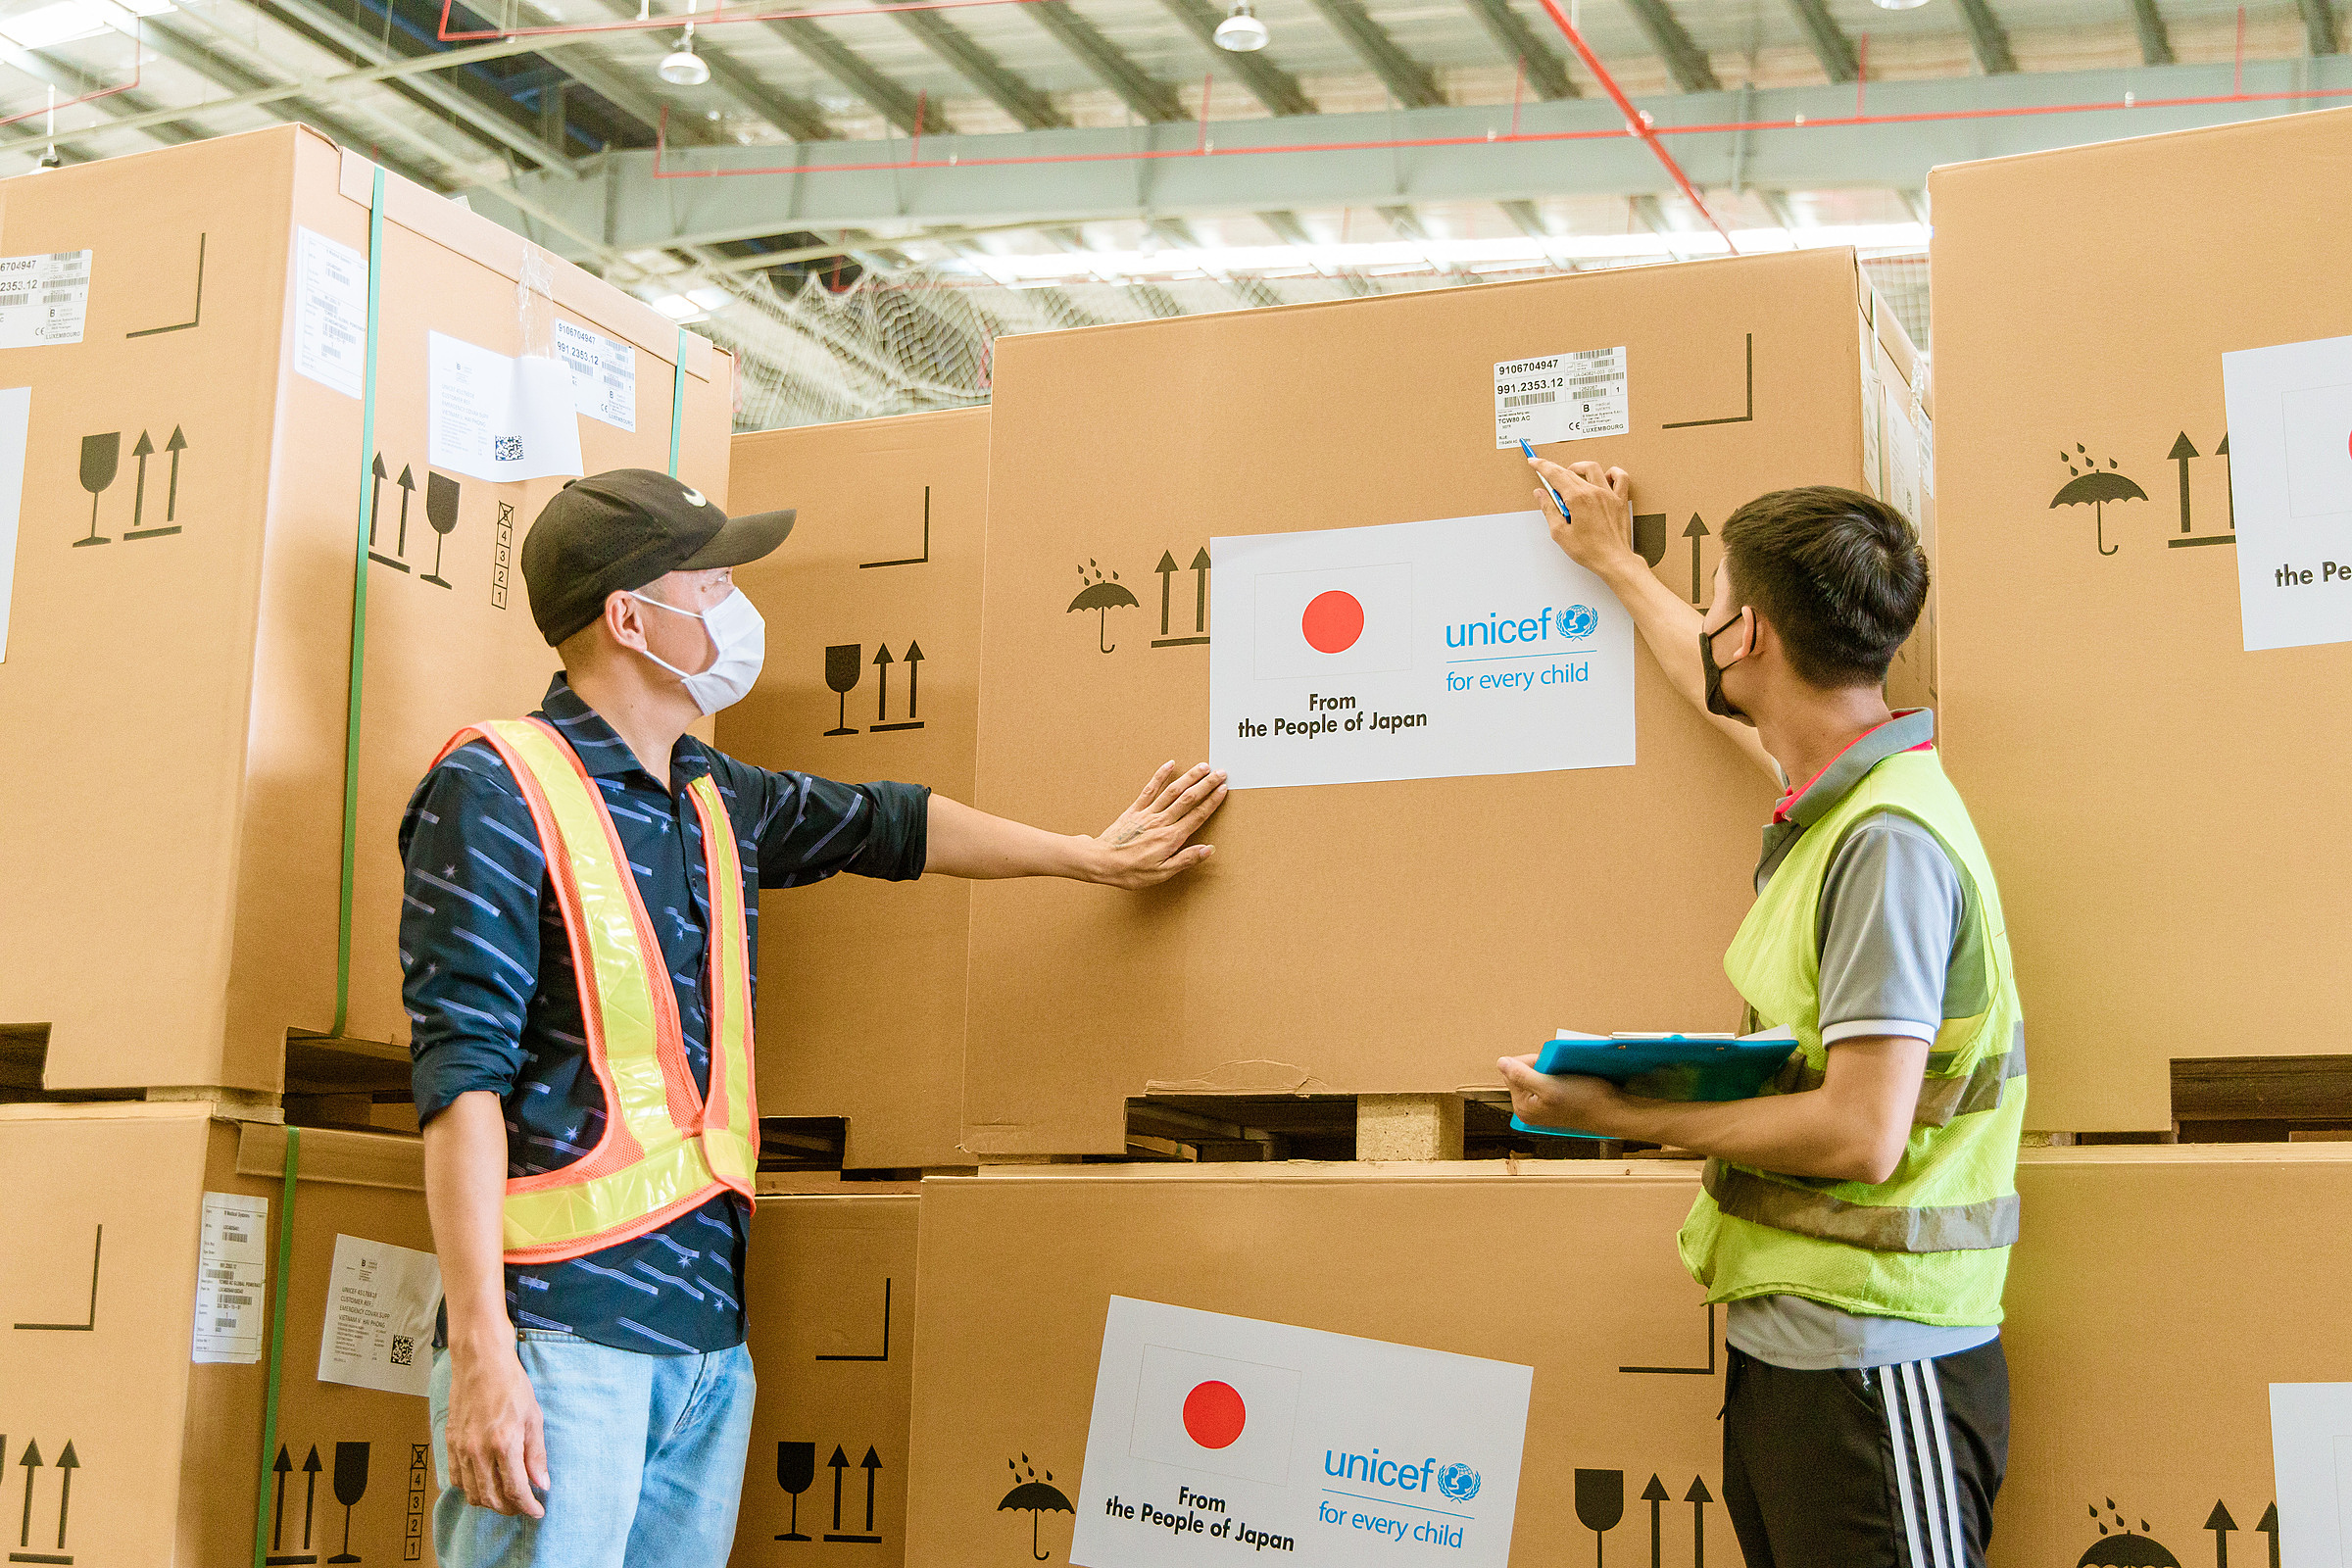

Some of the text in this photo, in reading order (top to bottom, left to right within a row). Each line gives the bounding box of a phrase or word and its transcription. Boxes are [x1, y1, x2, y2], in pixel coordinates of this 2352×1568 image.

[50, 309, 55, 318] B
[559, 323, 596, 345] 9106704947
[1498, 359, 1558, 375] 9106704947
[1497, 378, 1564, 395] 991.2353.12
[1583, 404, 1590, 413] B
[1582, 423, 1624, 433] LUXEMBOURG
[502, 530, 507, 541] 4
[500, 550, 506, 562] 3
[498, 570, 504, 582] 2
[2275, 564, 2313, 587] the
[498, 591, 501, 603] 1
[1446, 607, 1551, 648] unicef
[1446, 662, 1589, 692] for every child
[1308, 692, 1356, 711] From
[1238, 710, 1428, 740] the People of Japan
[1324, 1447, 1436, 1493] unicef
[415, 1473, 420, 1486] 4
[413, 1496, 419, 1509] 3
[1178, 1486, 1226, 1514] From
[412, 1519, 418, 1532] 2
[1105, 1496, 1295, 1551] the People of Japan
[1318, 1500, 1463, 1548] for every child
[411, 1542, 416, 1554] 1
